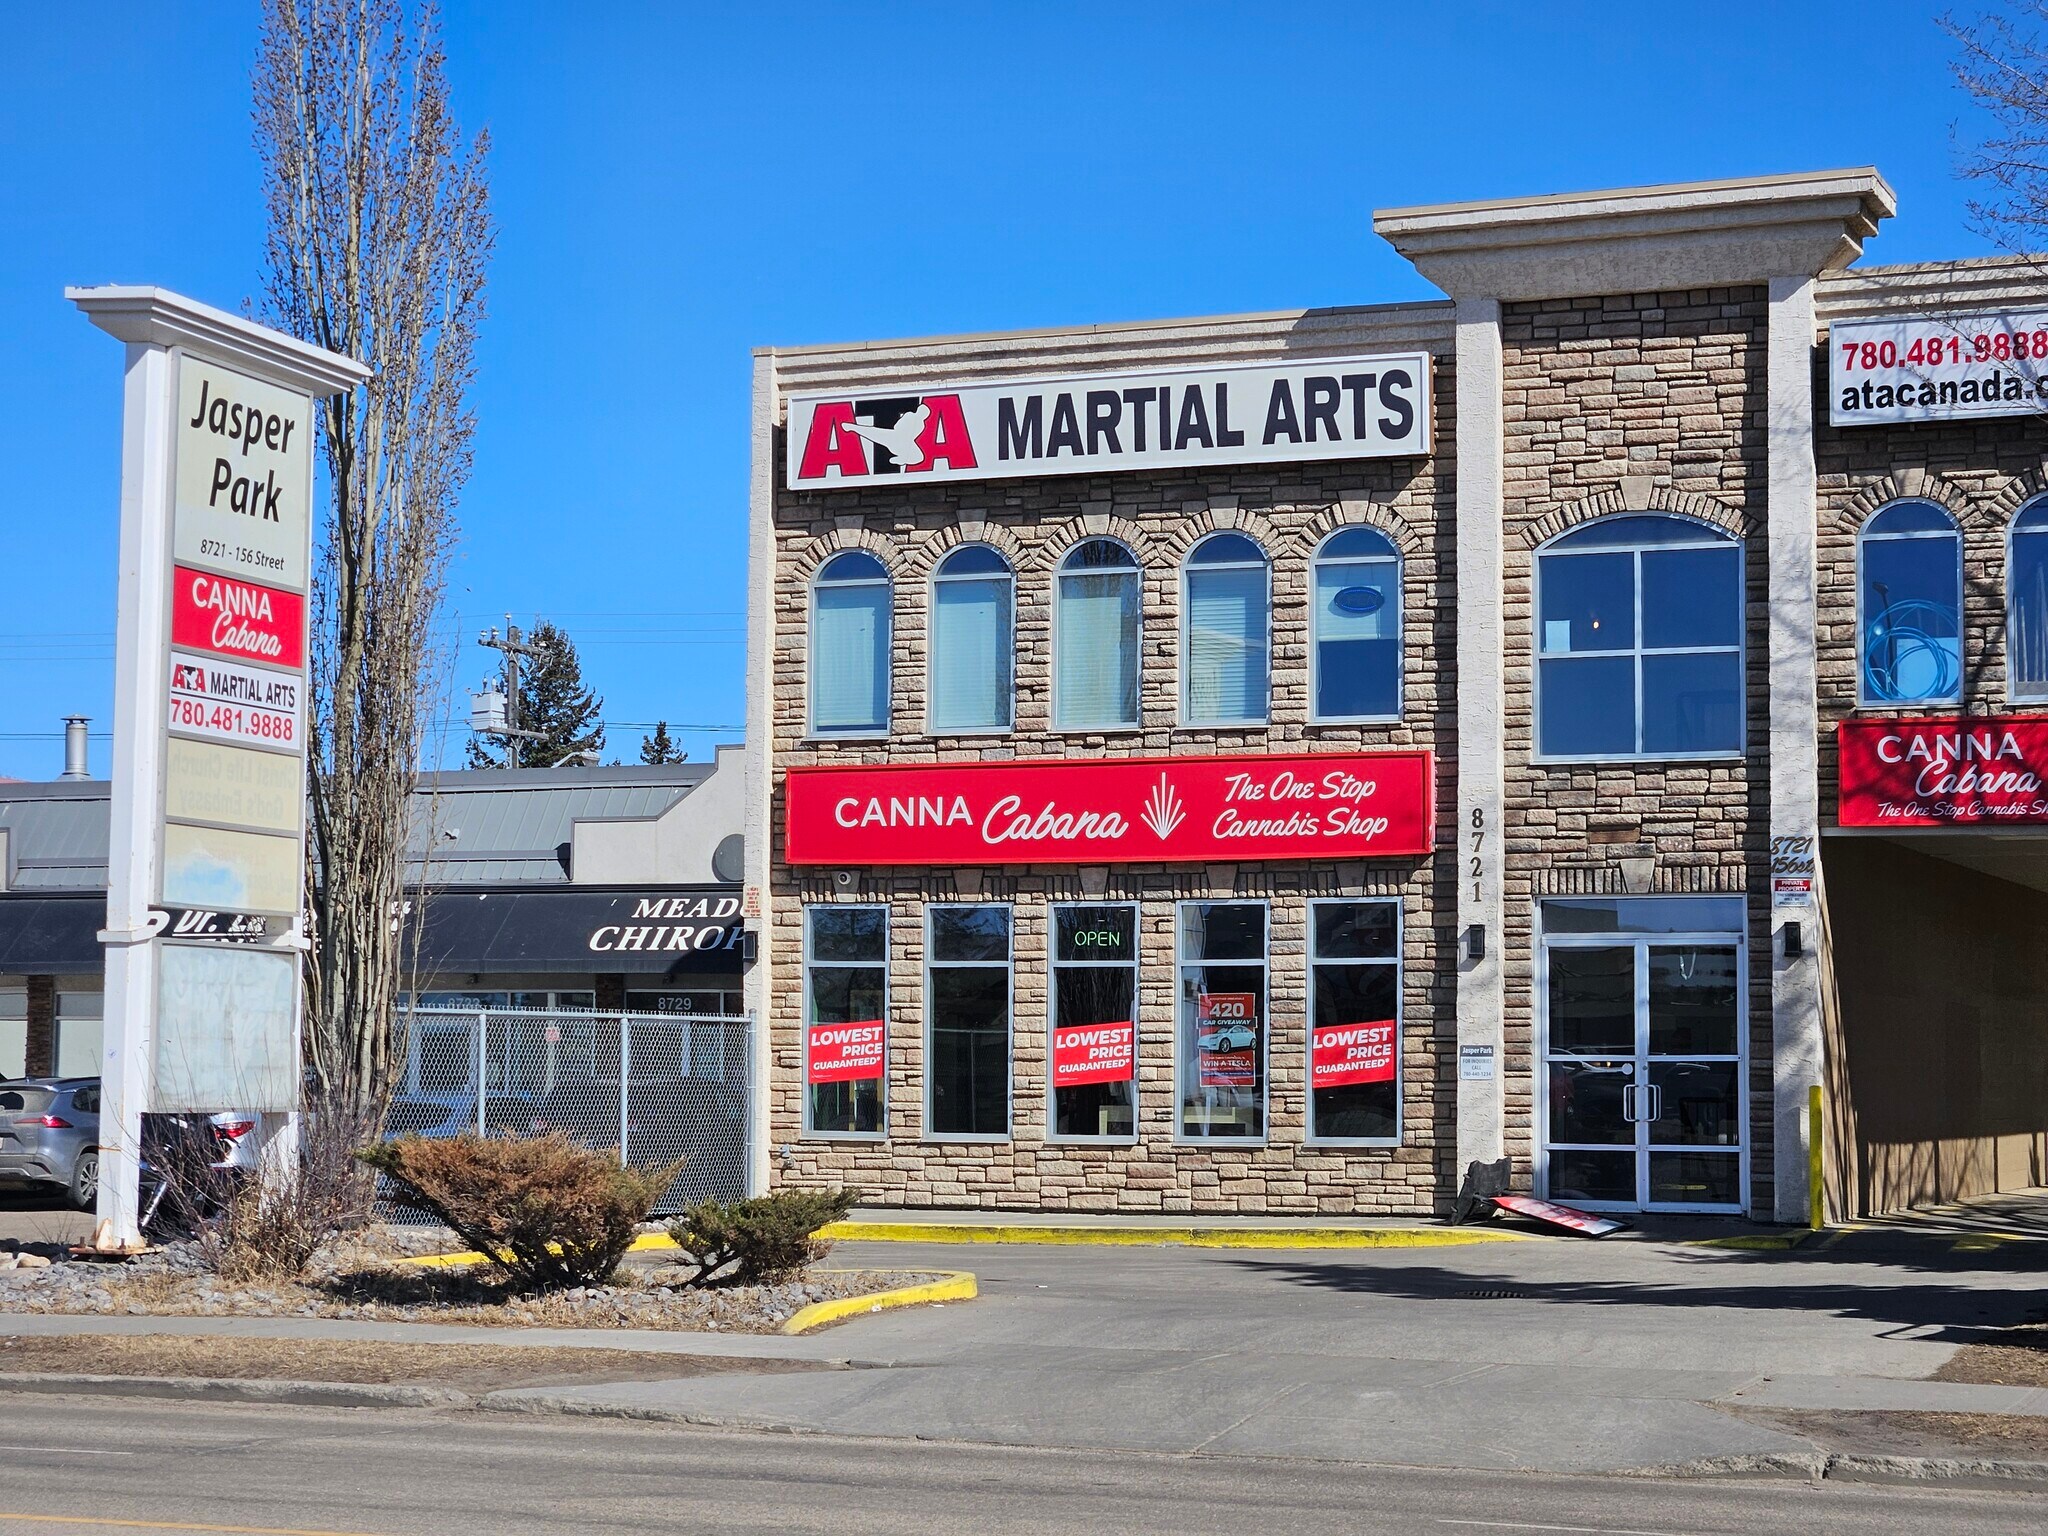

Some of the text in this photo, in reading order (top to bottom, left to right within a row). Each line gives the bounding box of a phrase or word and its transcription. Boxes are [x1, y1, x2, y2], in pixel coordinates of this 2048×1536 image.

[1842, 330, 2048, 371] 780.481.9888
[190, 379, 295, 456] Jasper
[798, 369, 1415, 479] ATA MARTIAL ARTS
[209, 457, 284, 523] Park
[200, 539, 226, 560] 8721
[235, 546, 254, 565] 156
[255, 548, 285, 571] Street
[192, 577, 273, 623] CANNA
[212, 610, 282, 657] Cabana
[172, 663, 295, 709] ATA MARTIAL ARTS
[170, 699, 294, 741] 780.481.9888
[1876, 732, 2024, 764] CANNA
[1225, 770, 1377, 806] The One Stop
[1915, 758, 2041, 798] Cabana
[834, 795, 1130, 844] CANNA Cabana
[1212, 807, 1389, 842] Cannabis Shop
[1877, 801, 1901, 817] The
[1903, 801, 1929, 817] One
[1932, 801, 1964, 819] Stop
[1967, 800, 2028, 816] Cannabis
[1469, 807, 1485, 903] 8721
[1770, 836, 1814, 855] 8721
[631, 898, 744, 918] MEAD
[1074, 930, 1120, 947] OPEN
[657, 997, 692, 1010] 8729
[1209, 1002, 1245, 1017] 420
[811, 1026, 883, 1047] LOWEST
[842, 1042, 883, 1058] PRICE
[1056, 1027, 1133, 1049] LOWEST
[1088, 1043, 1132, 1059] PRICE
[1312, 1026, 1392, 1049] LOWEST
[1347, 1043, 1391, 1060] PRICE
[1462, 1046, 1493, 1055] Jasper Park
